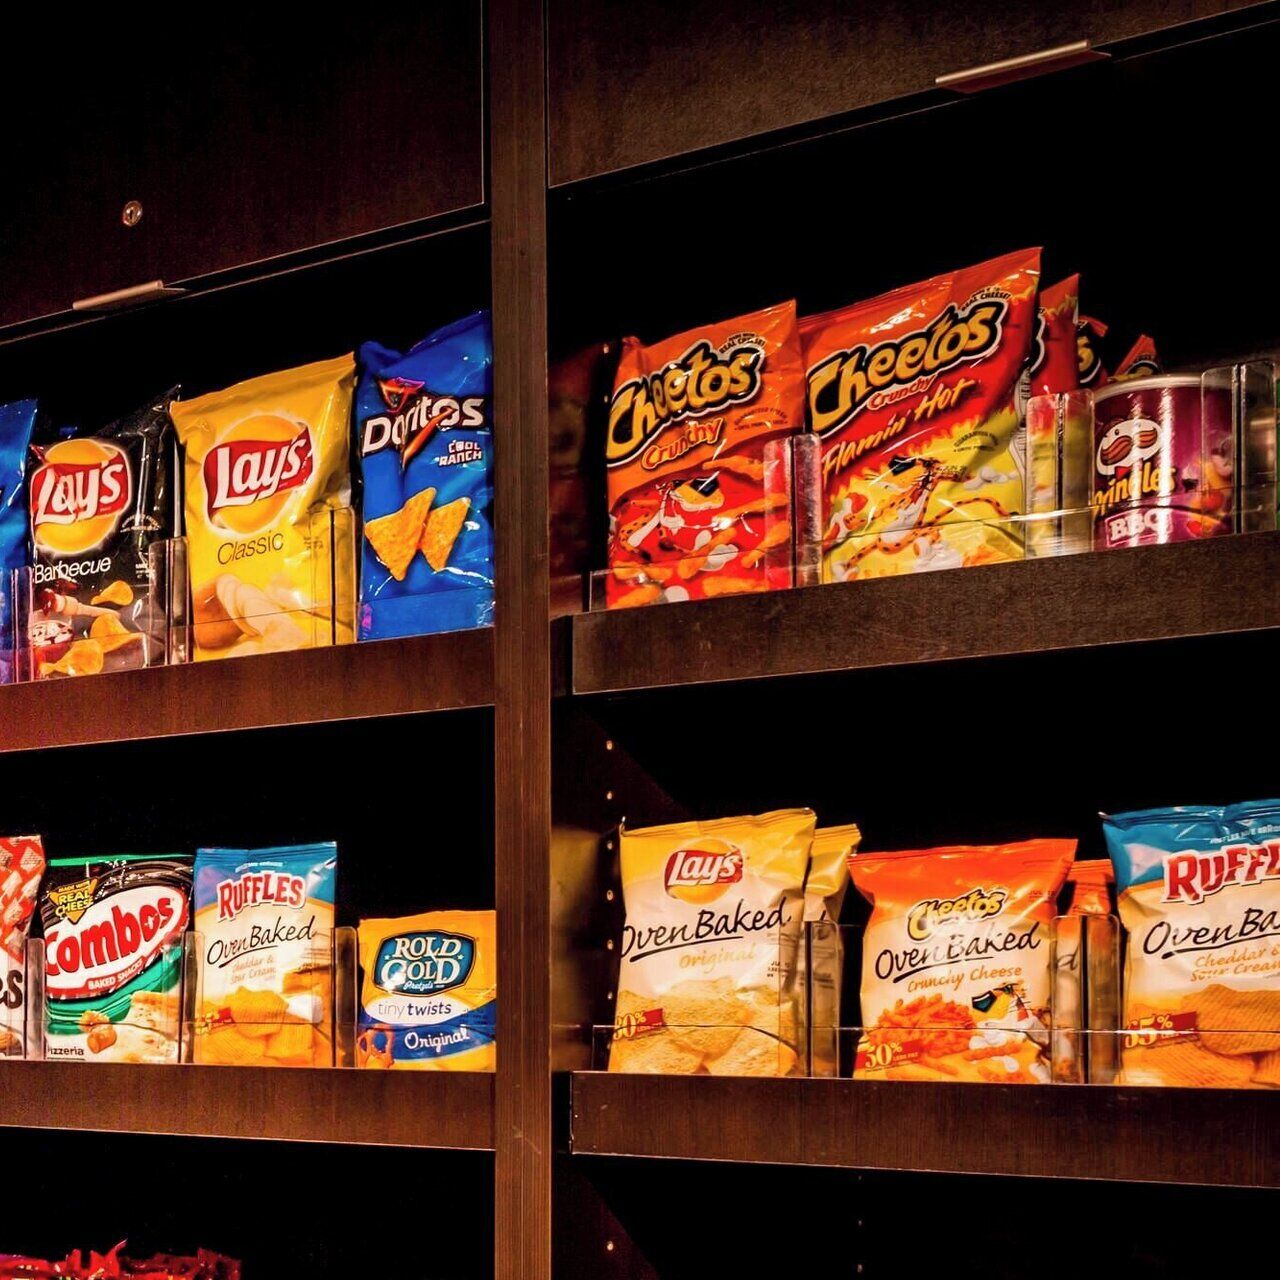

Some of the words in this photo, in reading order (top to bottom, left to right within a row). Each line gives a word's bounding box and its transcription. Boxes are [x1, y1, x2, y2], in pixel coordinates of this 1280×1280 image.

[809, 302, 1003, 432] Cheetos
[606, 343, 759, 460] Cheetos
[867, 374, 938, 410] Crunchy
[362, 396, 485, 455] Doritos
[822, 409, 912, 489] Flamin'
[914, 377, 976, 420] Hot
[438, 450, 483, 467] RANCH
[448, 440, 481, 454] COOL
[642, 418, 724, 469] Crunchy
[212, 436, 308, 508] Lay's
[35, 461, 124, 524] Lay's
[1109, 513, 1166, 540] BBQ
[217, 532, 284, 565] Classic
[34, 556, 112, 584] Barbecue
[666, 851, 742, 886] Lay's
[55, 900, 94, 917] CHEESE
[59, 891, 90, 905] REAL
[218, 873, 305, 920] RUFFLES
[908, 889, 1007, 941] Cheetos
[44, 898, 174, 976] Combos
[392, 936, 462, 961] ROLD
[381, 958, 461, 985] GOLD
[1195, 945, 1266, 968] Cheddar
[88, 978, 116, 990] BAKED
[378, 1003, 404, 1019] tiny
[407, 1001, 452, 1015] twists
[48, 1045, 85, 1056] izzeria
[404, 1024, 470, 1053] Original
